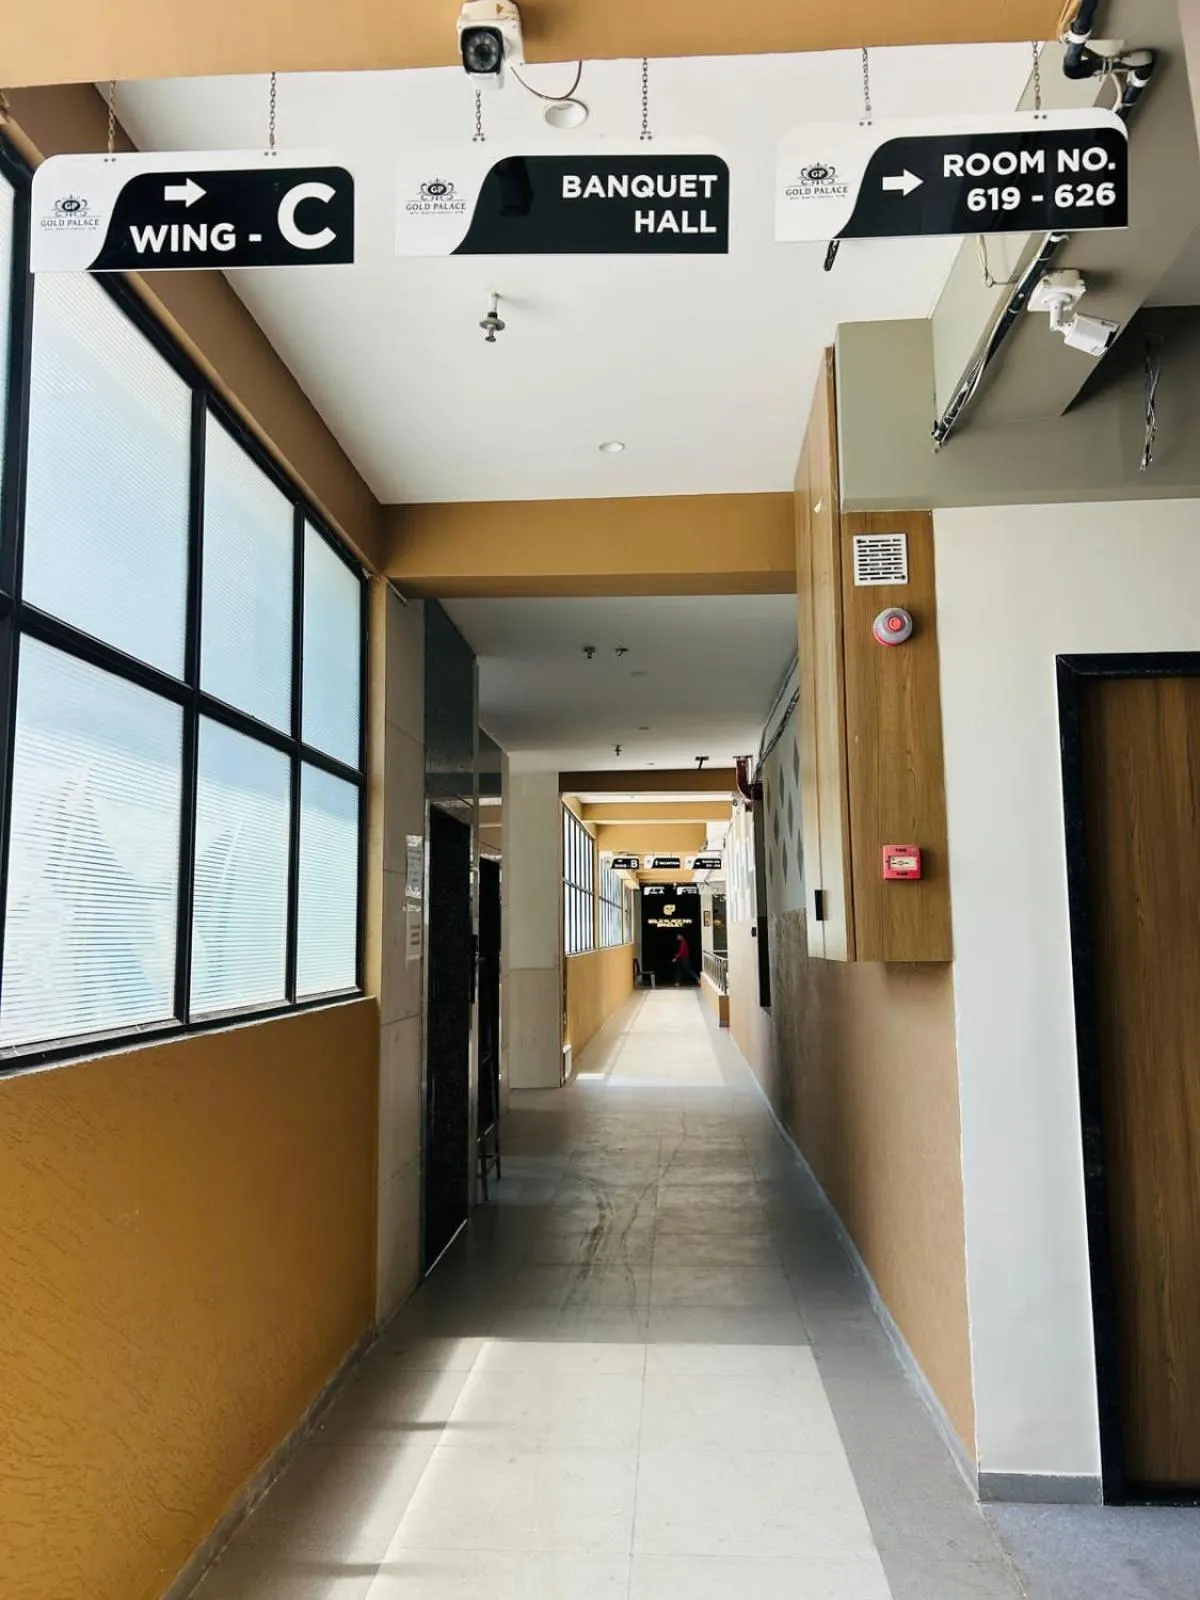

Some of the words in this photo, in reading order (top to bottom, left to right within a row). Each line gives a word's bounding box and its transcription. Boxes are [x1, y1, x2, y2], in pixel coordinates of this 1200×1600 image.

[944, 150, 1044, 177] ROOM
[1058, 147, 1115, 172] NO.
[562, 175, 717, 199] BANQUET
[785, 188, 811, 196] GOLD
[814, 186, 848, 195] PALACE
[968, 187, 1020, 211] 619
[1055, 183, 1115, 207] 626
[433, 202, 466, 210] PALACE
[41, 219, 65, 227] GOLD
[67, 218, 100, 226] PALACE
[130, 223, 236, 253] WING
[278, 183, 337, 250] C
[634, 210, 717, 233] HALL
